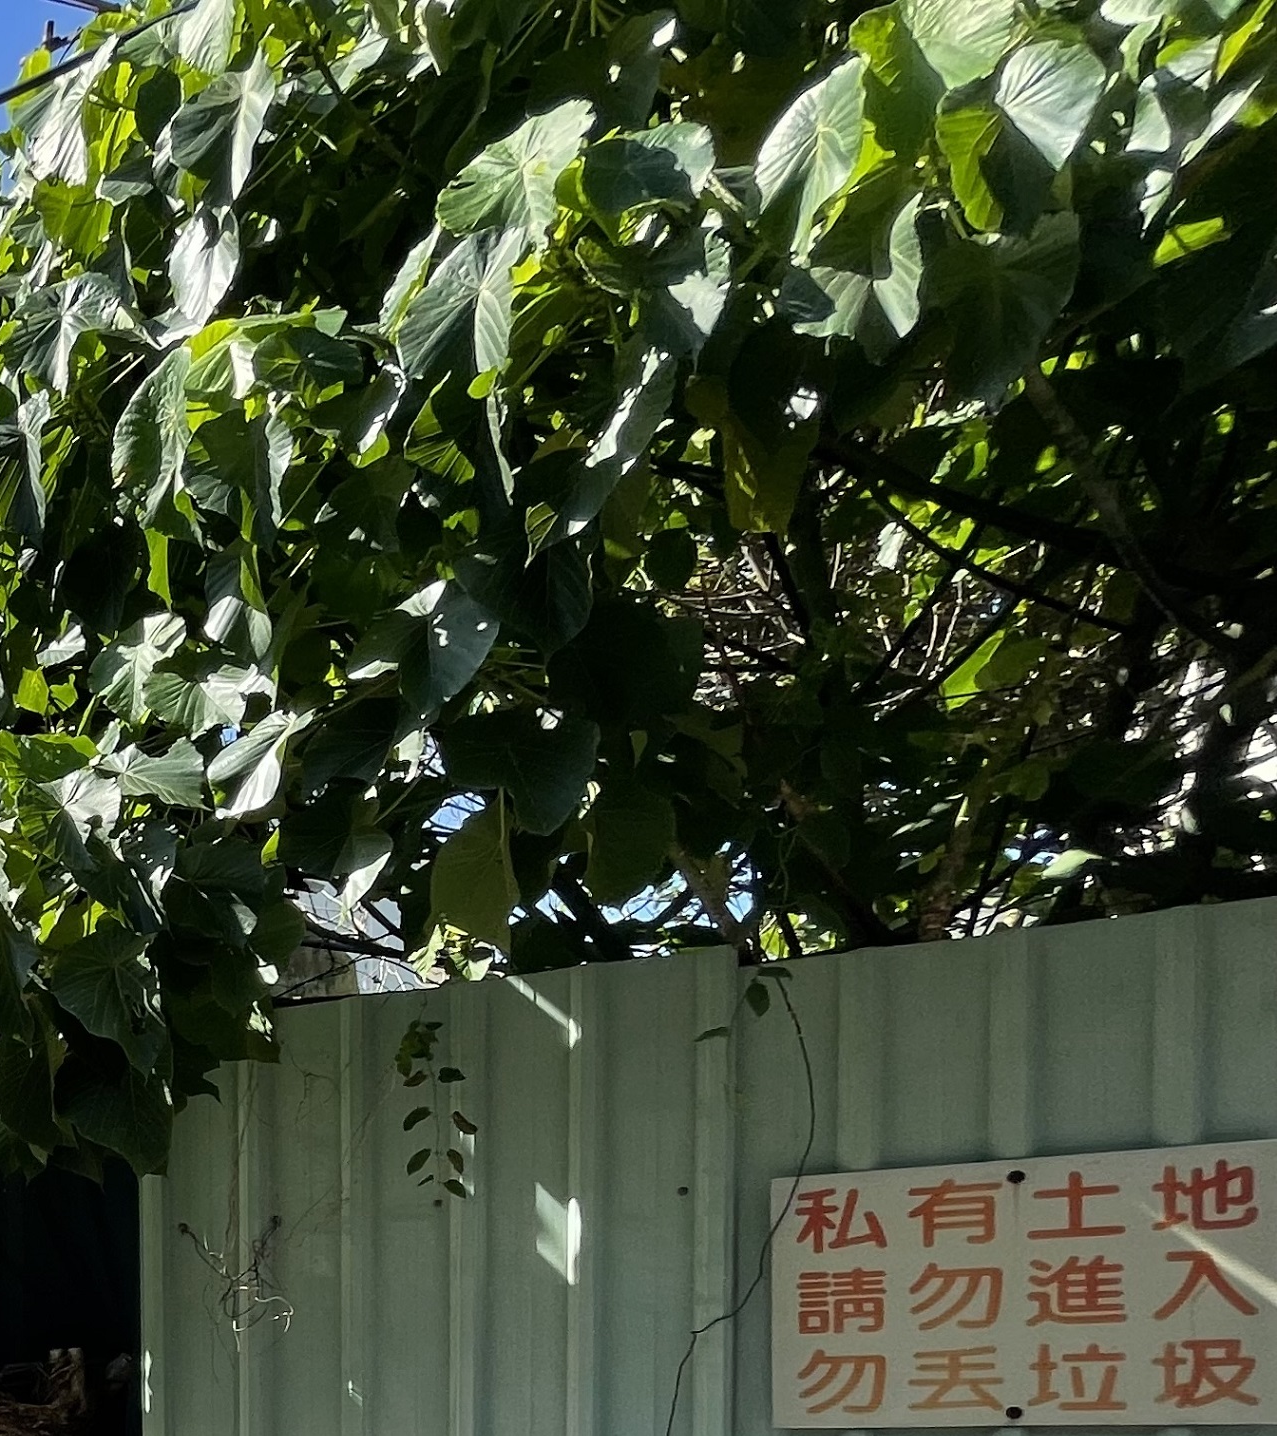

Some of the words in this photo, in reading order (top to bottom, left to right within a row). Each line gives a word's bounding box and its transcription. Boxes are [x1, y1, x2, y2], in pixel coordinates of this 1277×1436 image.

[795, 1159, 1260, 1254] 私有土地
[796, 1250, 1260, 1336] 請勿進入
[796, 1338, 1260, 1416] 勿丟垃圾
